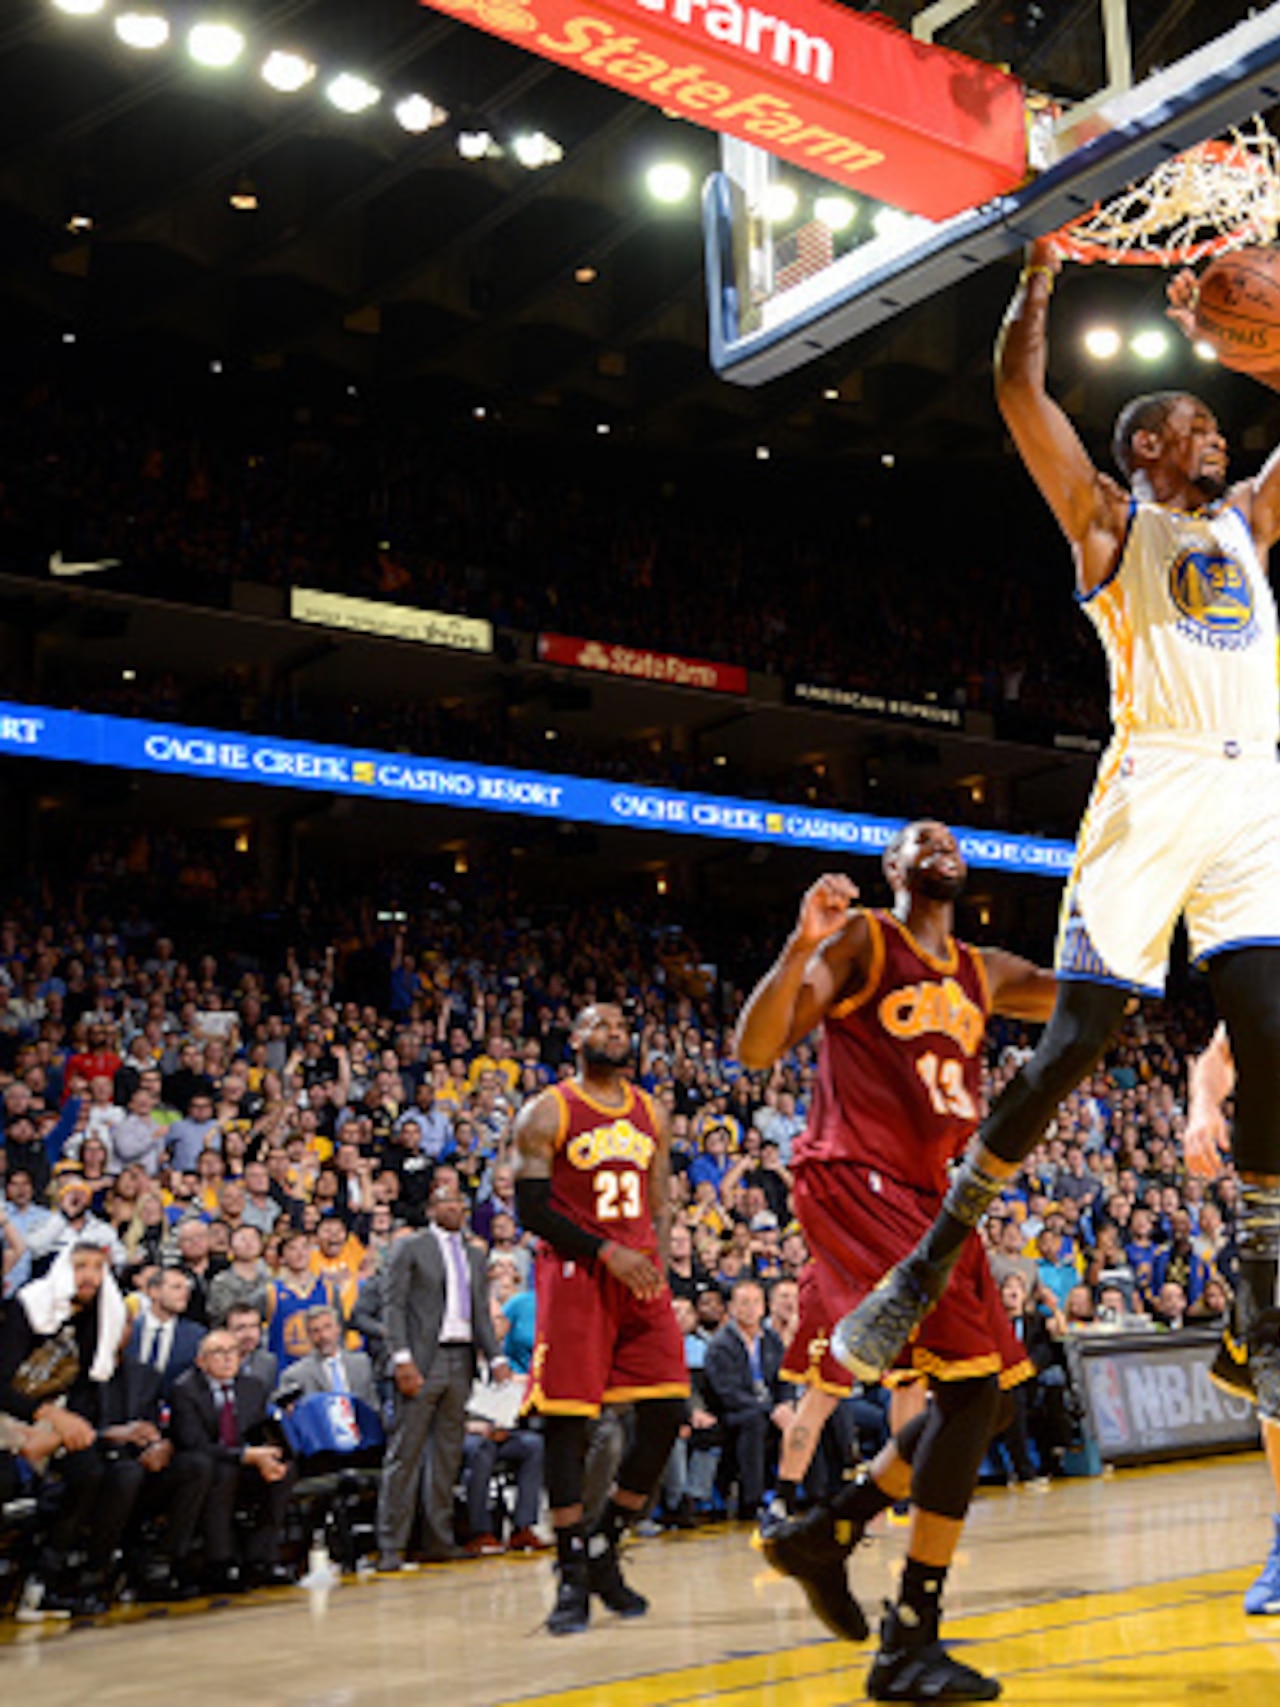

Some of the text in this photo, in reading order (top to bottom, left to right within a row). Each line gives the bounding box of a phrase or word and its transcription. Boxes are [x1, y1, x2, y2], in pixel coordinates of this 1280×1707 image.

[1207, 563, 1242, 588] 35
[145, 735, 563, 809] CACHE CREEK CASINO RESORT
[611, 792, 687, 822] CACHE
[691, 804, 764, 833] CREEK
[785, 817, 858, 843] CASINO
[594, 1170, 643, 1222] 23
